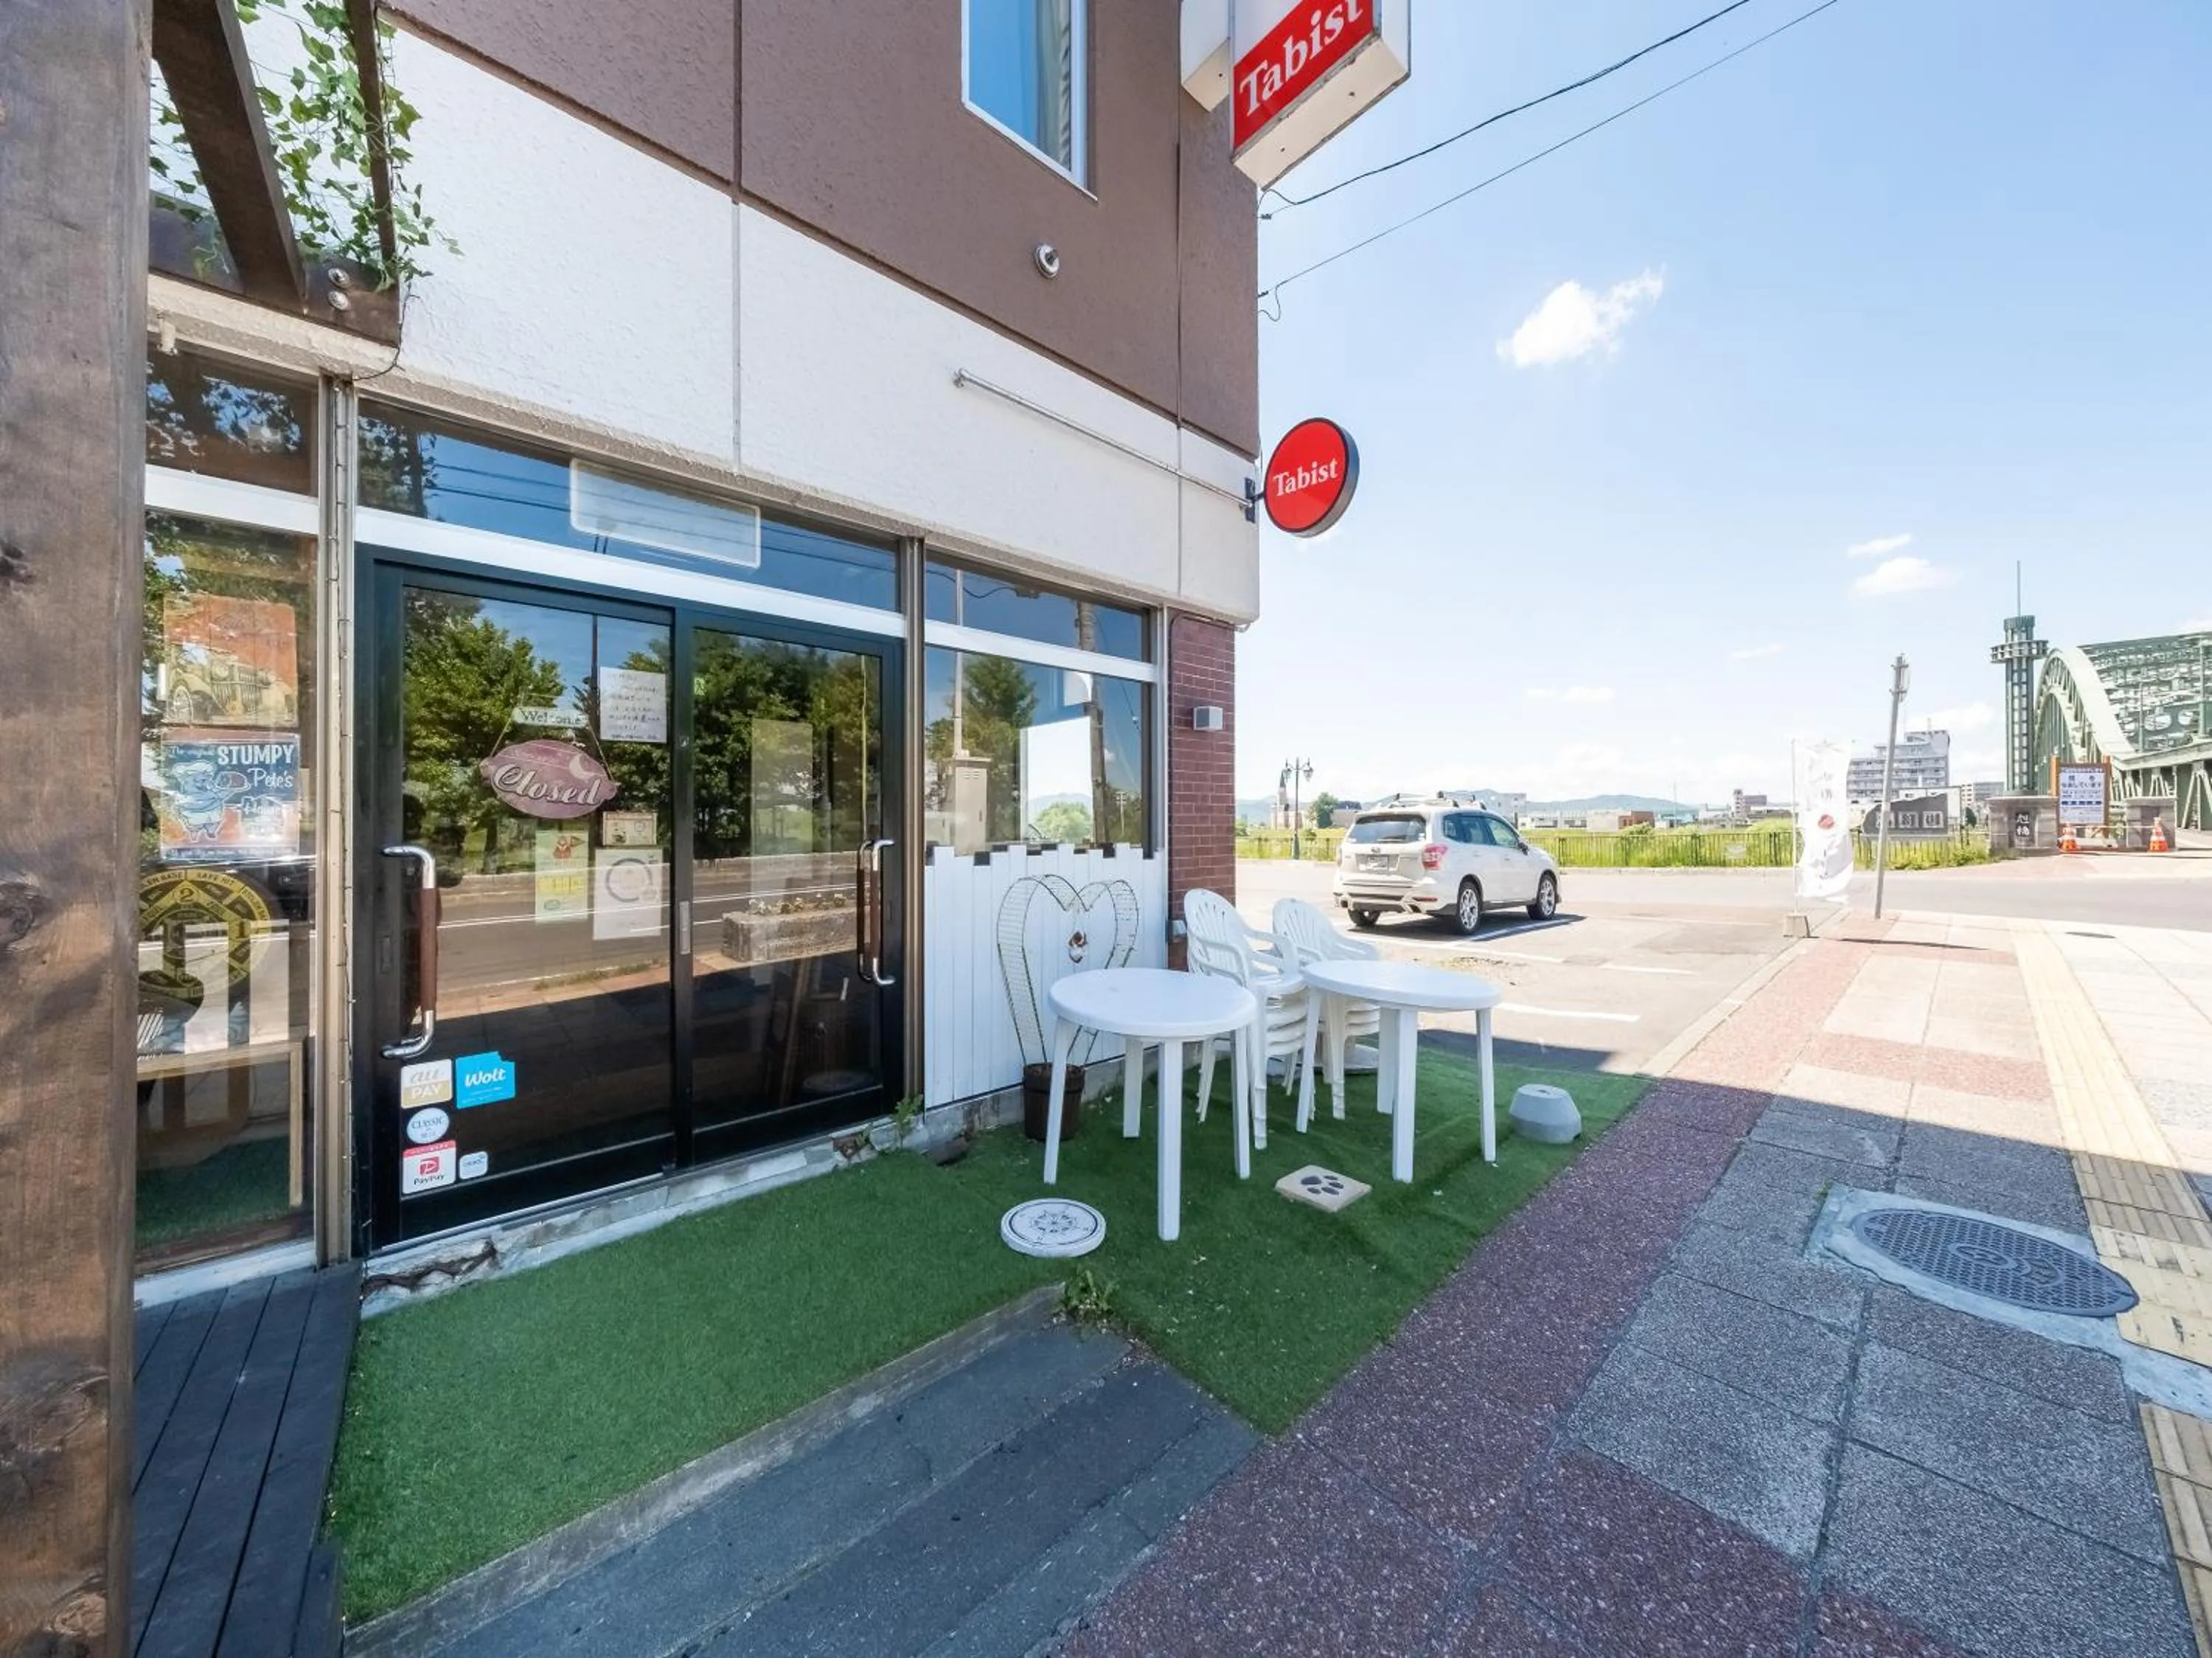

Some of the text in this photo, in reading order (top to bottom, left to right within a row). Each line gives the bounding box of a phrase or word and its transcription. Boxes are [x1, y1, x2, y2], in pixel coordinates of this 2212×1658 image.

[1239, 0, 1363, 117] Tabist
[1273, 457, 1338, 496] Tabist
[519, 707, 582, 725] Welcome
[218, 745, 293, 765] STUMPY
[247, 768, 293, 788] Pete's
[493, 763, 602, 805] Closed
[2017, 813, 2030, 836] 旭橋
[179, 888, 194, 902] 2
[465, 1067, 507, 1088] Wolt
[412, 1083, 442, 1100] PAY
[414, 1172, 445, 1186] PayPay
